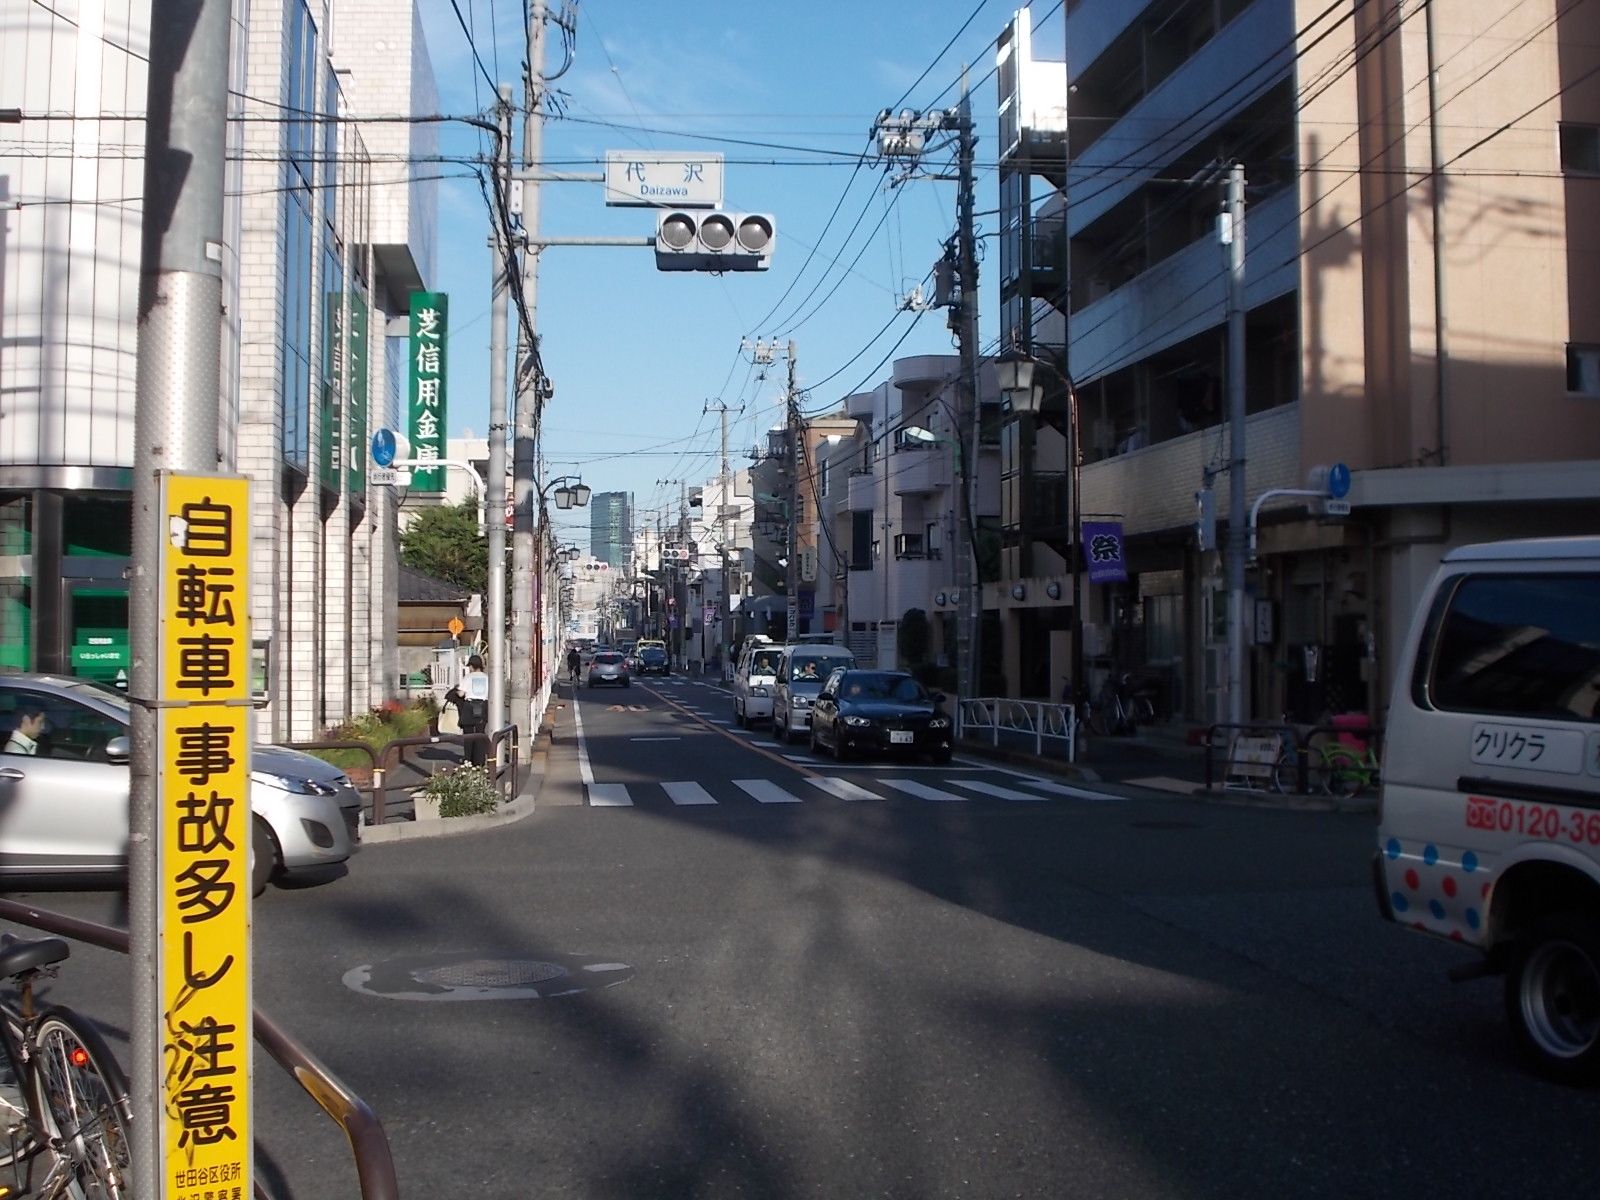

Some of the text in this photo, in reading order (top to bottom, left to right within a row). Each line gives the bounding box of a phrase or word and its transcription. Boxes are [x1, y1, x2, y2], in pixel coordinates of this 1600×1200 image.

[625, 161, 704, 183] 代沢
[640, 184, 689, 196] Daizawa
[415, 308, 441, 475] 芝信用金庫
[1090, 533, 1121, 563] 祭
[1474, 728, 1546, 762] クリクラ
[175, 1161, 241, 1189] 世田谷区役所
